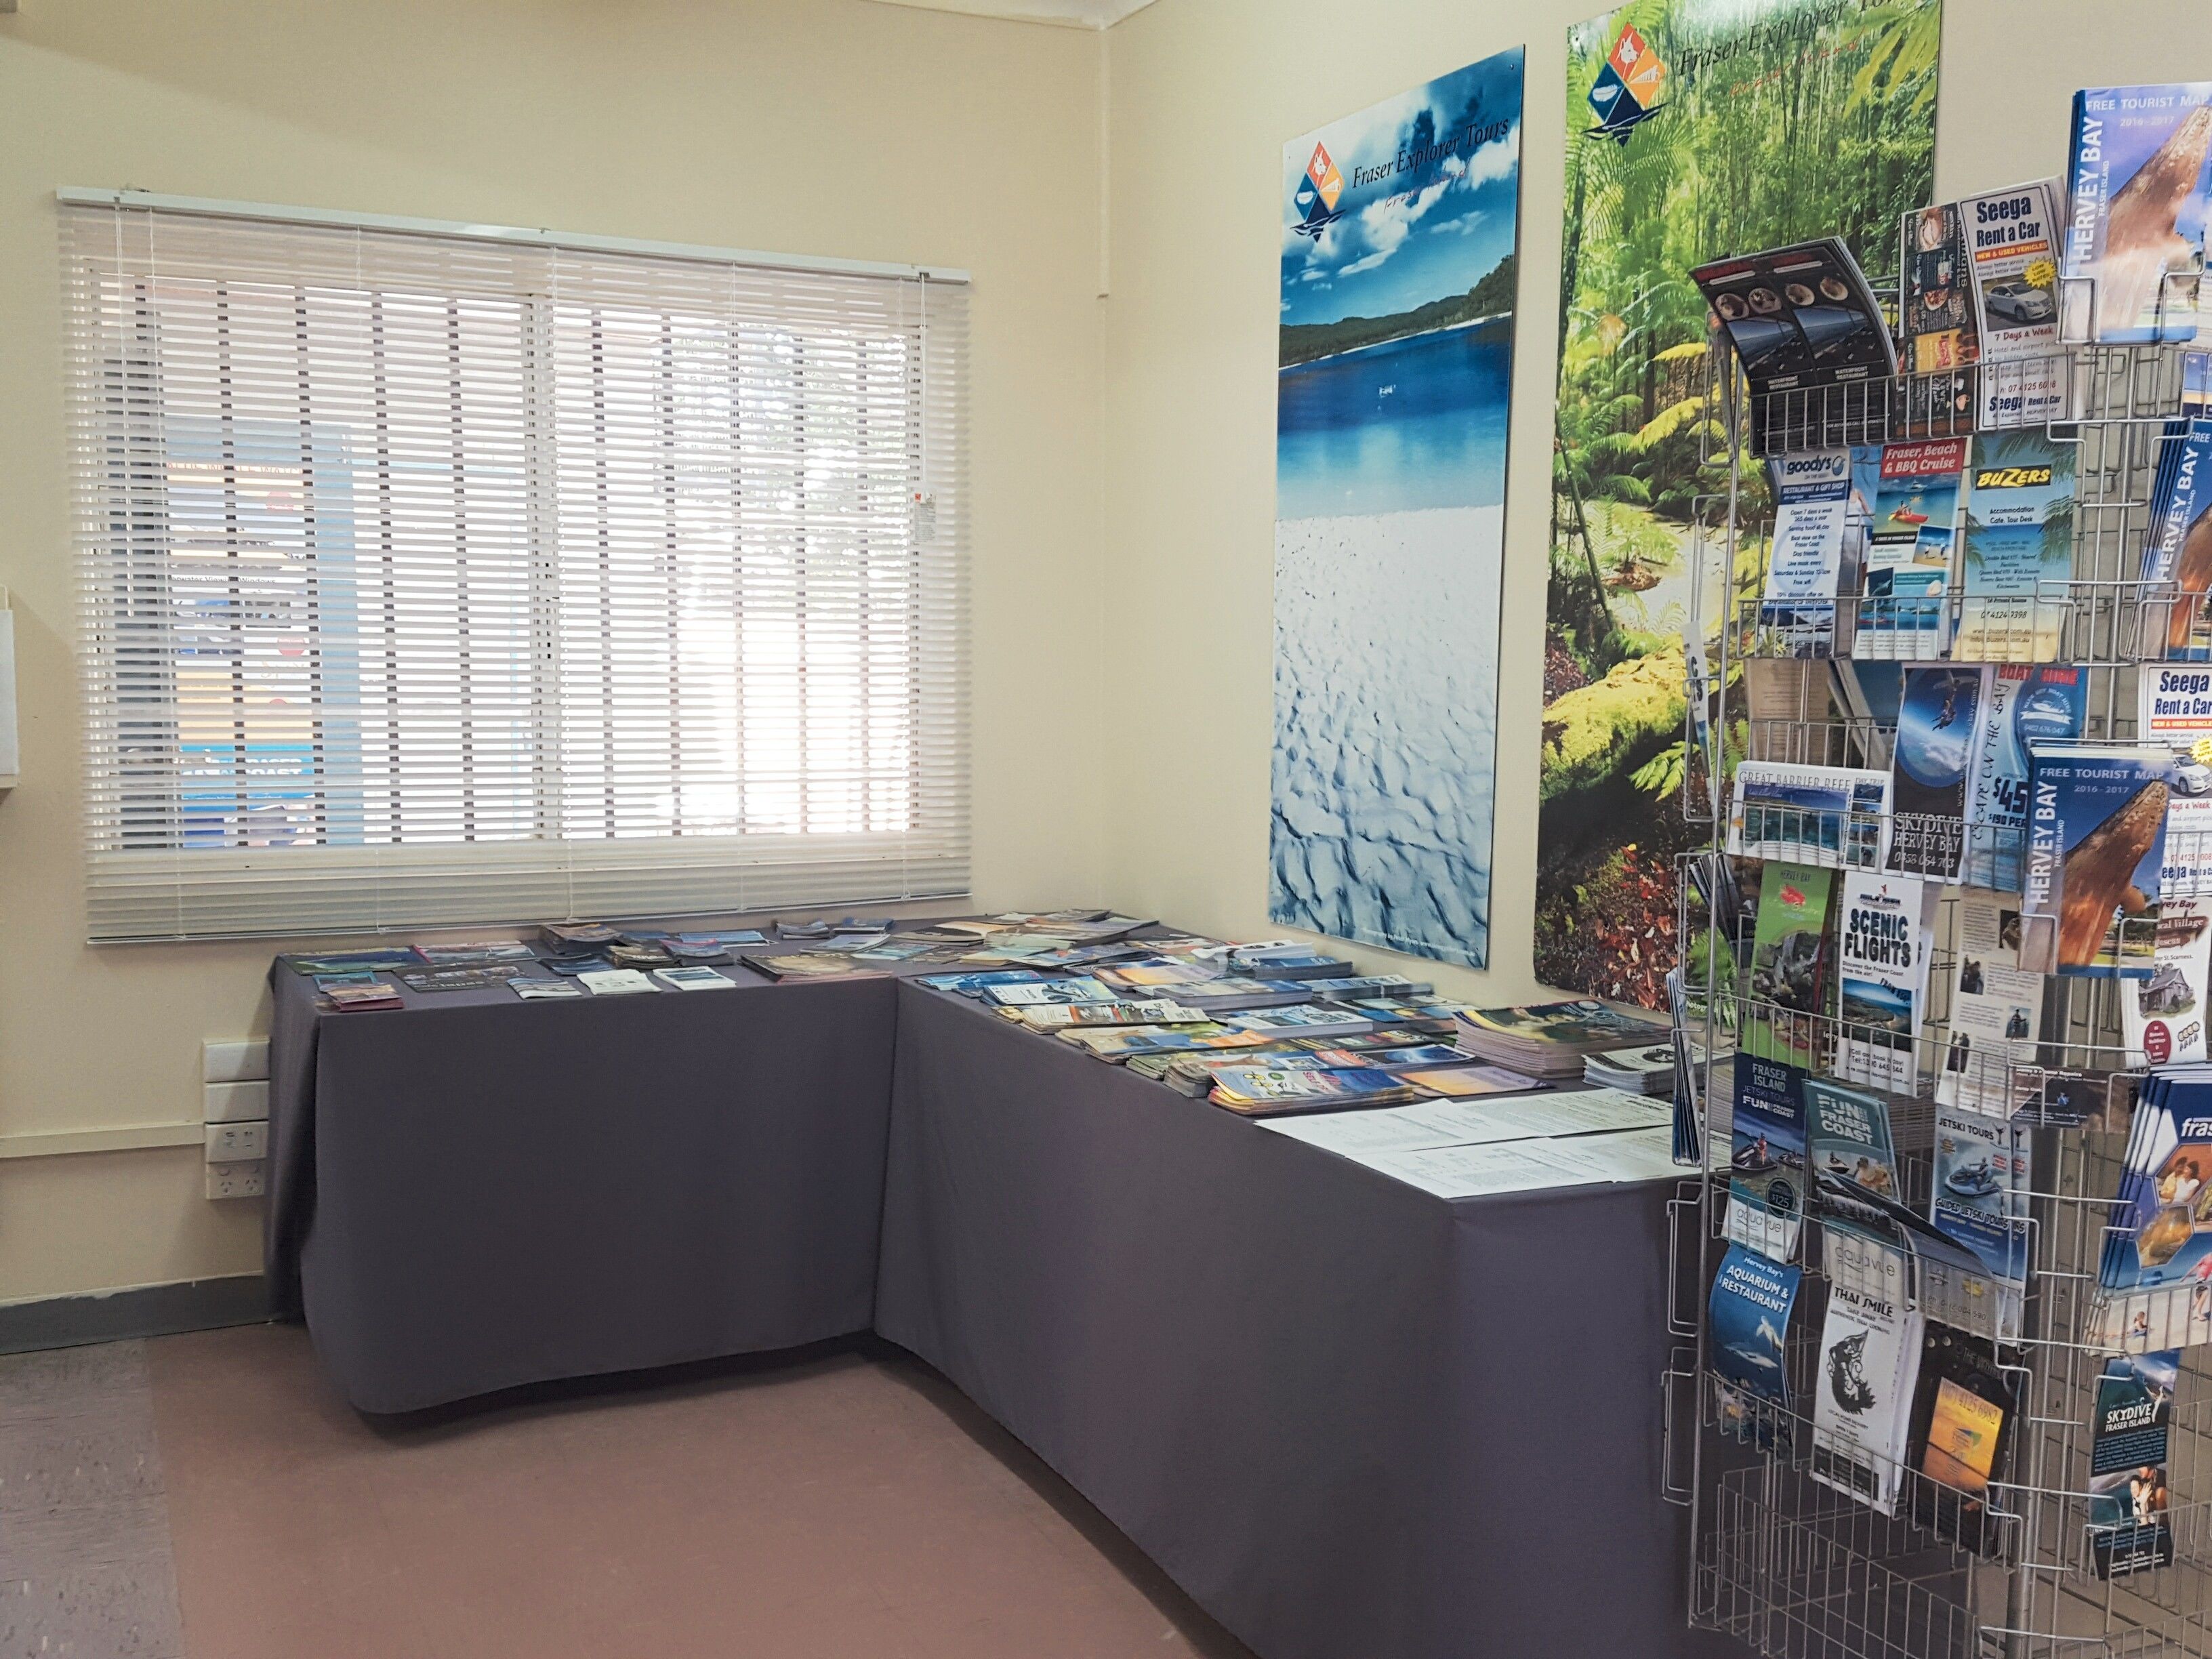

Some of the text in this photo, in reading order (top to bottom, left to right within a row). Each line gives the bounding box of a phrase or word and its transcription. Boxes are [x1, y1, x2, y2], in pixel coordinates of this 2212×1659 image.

[1678, 0, 1848, 76] Fraser Explorer
[1730, 62, 1793, 97] Fraser
[2086, 96, 2211, 111] FREE TOURIST MAP
[1353, 119, 1509, 189] Fraser Explorer Tours
[2073, 117, 2102, 261] HERVEY BAY
[1977, 197, 2031, 223] Seega
[1977, 222, 2040, 247] Rent a Car
[1977, 251, 1990, 260] NEW
[1999, 248, 2015, 256] USED
[2018, 243, 2047, 253] VEHICLES
[2004, 332, 2022, 342] Days
[2032, 327, 2053, 336] Week
[2008, 384, 2017, 393] 07
[2039, 380, 2056, 390] 608
[2049, 395, 2062, 404] Car
[2189, 432, 2211, 443] FREE
[1886, 442, 1957, 460] Fraser, Beach
[1787, 455, 1832, 475] goody's
[1885, 457, 1955, 473] & BBQ Cruise
[1978, 468, 2050, 487] BUZERS
[1990, 506, 2034, 514] Accommodation
[2156, 446, 2199, 581] HERVEY BAY
[1990, 611, 2007, 619] 4124
[2011, 611, 2027, 619] 7398
[2160, 670, 2209, 695] Seega
[2155, 697, 2212, 714] Rent a Car
[1986, 720, 2001, 749] THE
[1739, 771, 1773, 785] GREAT
[1777, 774, 1820, 789] BARRIER
[1824, 777, 1851, 792] REEF
[2040, 768, 2165, 780] FREE TOURIST MAP
[1993, 776, 2028, 814] $45
[2074, 785, 2097, 793] 2016
[2106, 785, 2130, 794] 2017
[2193, 801, 2211, 809] Week
[1895, 811, 1963, 835] SKYDIVE
[1989, 814, 2007, 826] $190
[1893, 832, 1961, 853] HERVEY BAY
[2029, 781, 2057, 904] HERVEY BAY
[2054, 819, 2065, 867] FRASER ISLAND
[2179, 900, 2198, 909] Bay
[1850, 908, 1908, 941] SCENIC
[2175, 918, 2204, 928] Village
[1845, 933, 1910, 968] FLIGHTS
[1843, 960, 1863, 969] Discover
[1873, 966, 1889, 974] Fraser
[1753, 1063, 1786, 1081] FRASER
[1753, 1075, 1786, 1092] ISLAND
[1742, 1086, 1795, 1106] JETSKI TOURS
[1742, 1095, 1768, 1110] FUN
[1817, 1092, 1860, 1118] FUN
[1774, 1108, 1795, 1119] COAST
[1820, 1109, 1872, 1133] FRASER
[1822, 1120, 1873, 1145] COAST
[1939, 1118, 1994, 1140] JETSKI TOURS
[1771, 1193, 1790, 1208] $125
[1935, 1197, 1961, 1213] GUIDED
[1961, 1206, 1985, 1223] JETSKI
[1744, 1256, 1784, 1278] Hervey Bay's
[1727, 1265, 1790, 1299] AQUARIUM &
[1722, 1277, 1787, 1313] RESTAURANT
[1835, 1287, 1893, 1317] THAI SMILE
[2107, 1404, 2152, 1424] SKYDIVE
[2106, 1417, 2150, 1432] FRASER ISLAND
